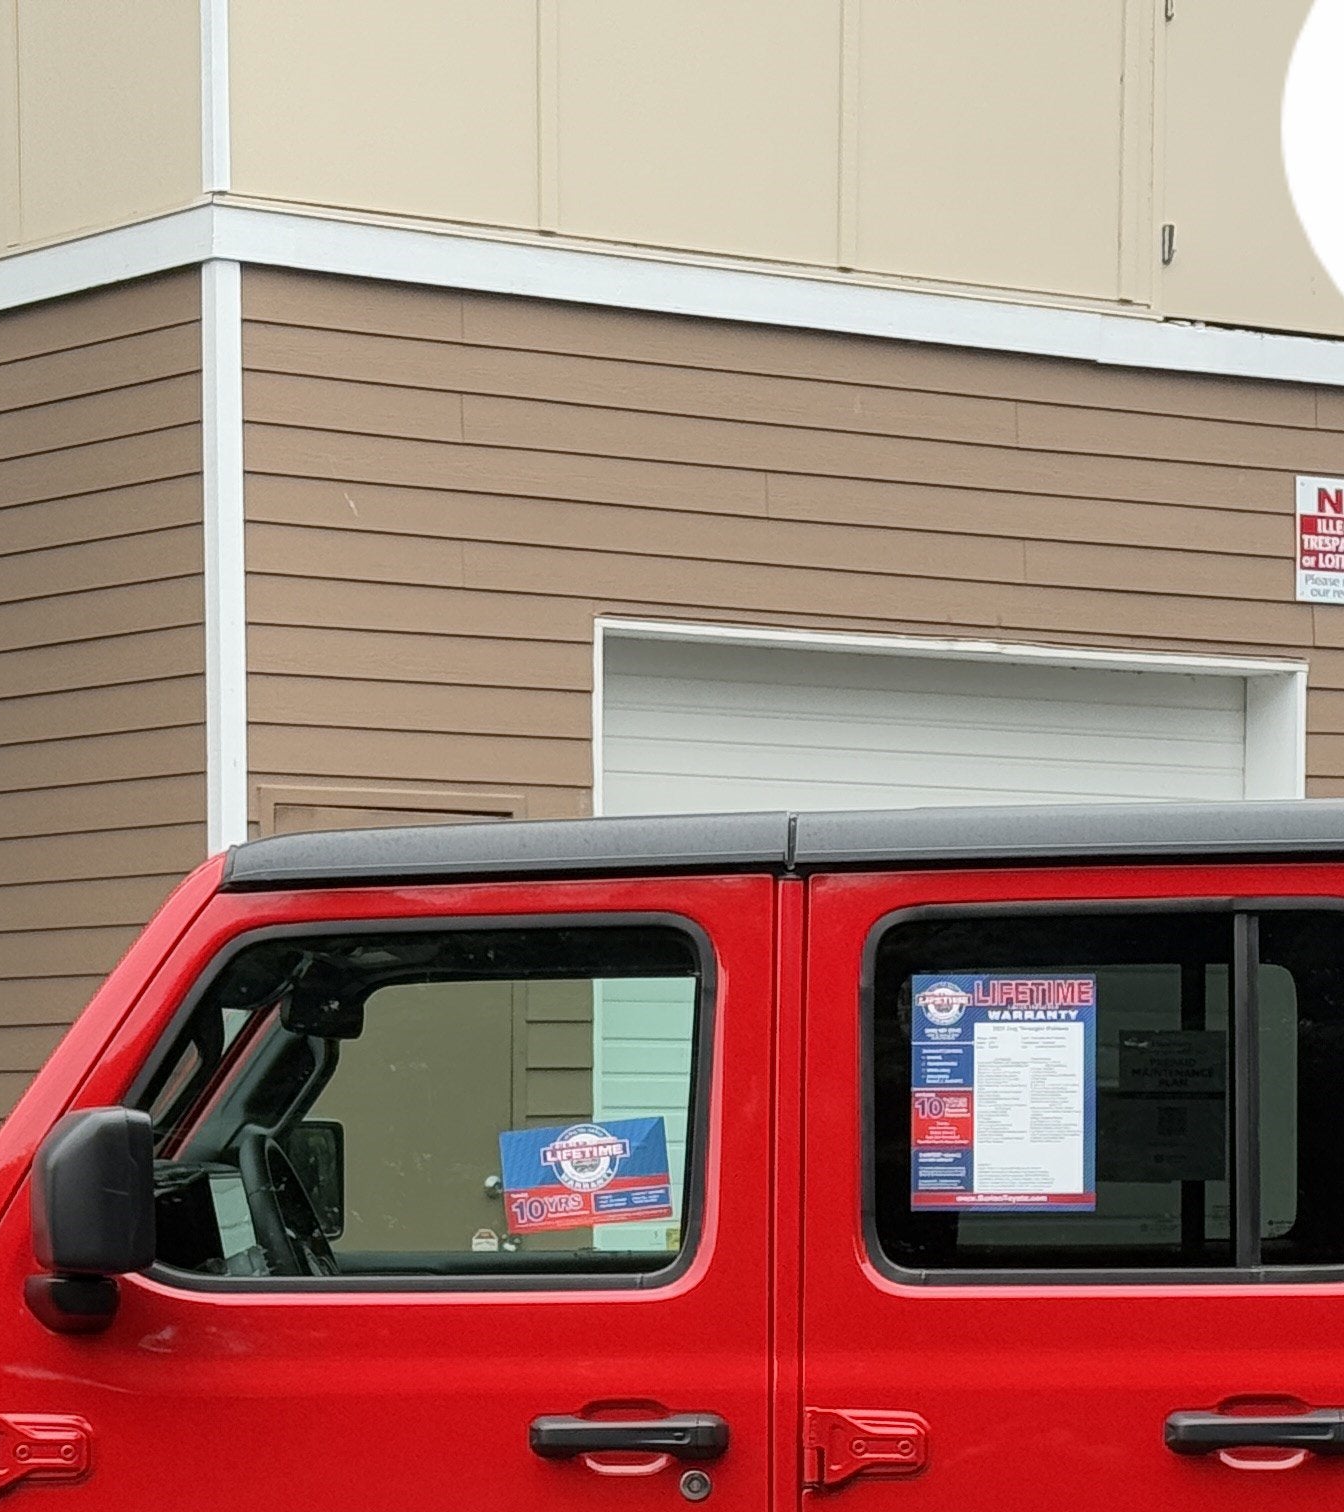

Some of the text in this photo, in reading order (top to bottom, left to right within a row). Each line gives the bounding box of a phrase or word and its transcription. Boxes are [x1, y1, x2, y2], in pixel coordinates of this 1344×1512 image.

[1302, 556, 1317, 567] or
[1305, 574, 1340, 587] Please
[1310, 588, 1330, 597] our
[974, 980, 1094, 1007] LIFETIME
[988, 1009, 1079, 1021] WARRANTY
[915, 1098, 945, 1119] 10
[546, 1141, 624, 1162] LIFETIME
[511, 1197, 548, 1224] 10
[545, 1193, 584, 1215] YRS
